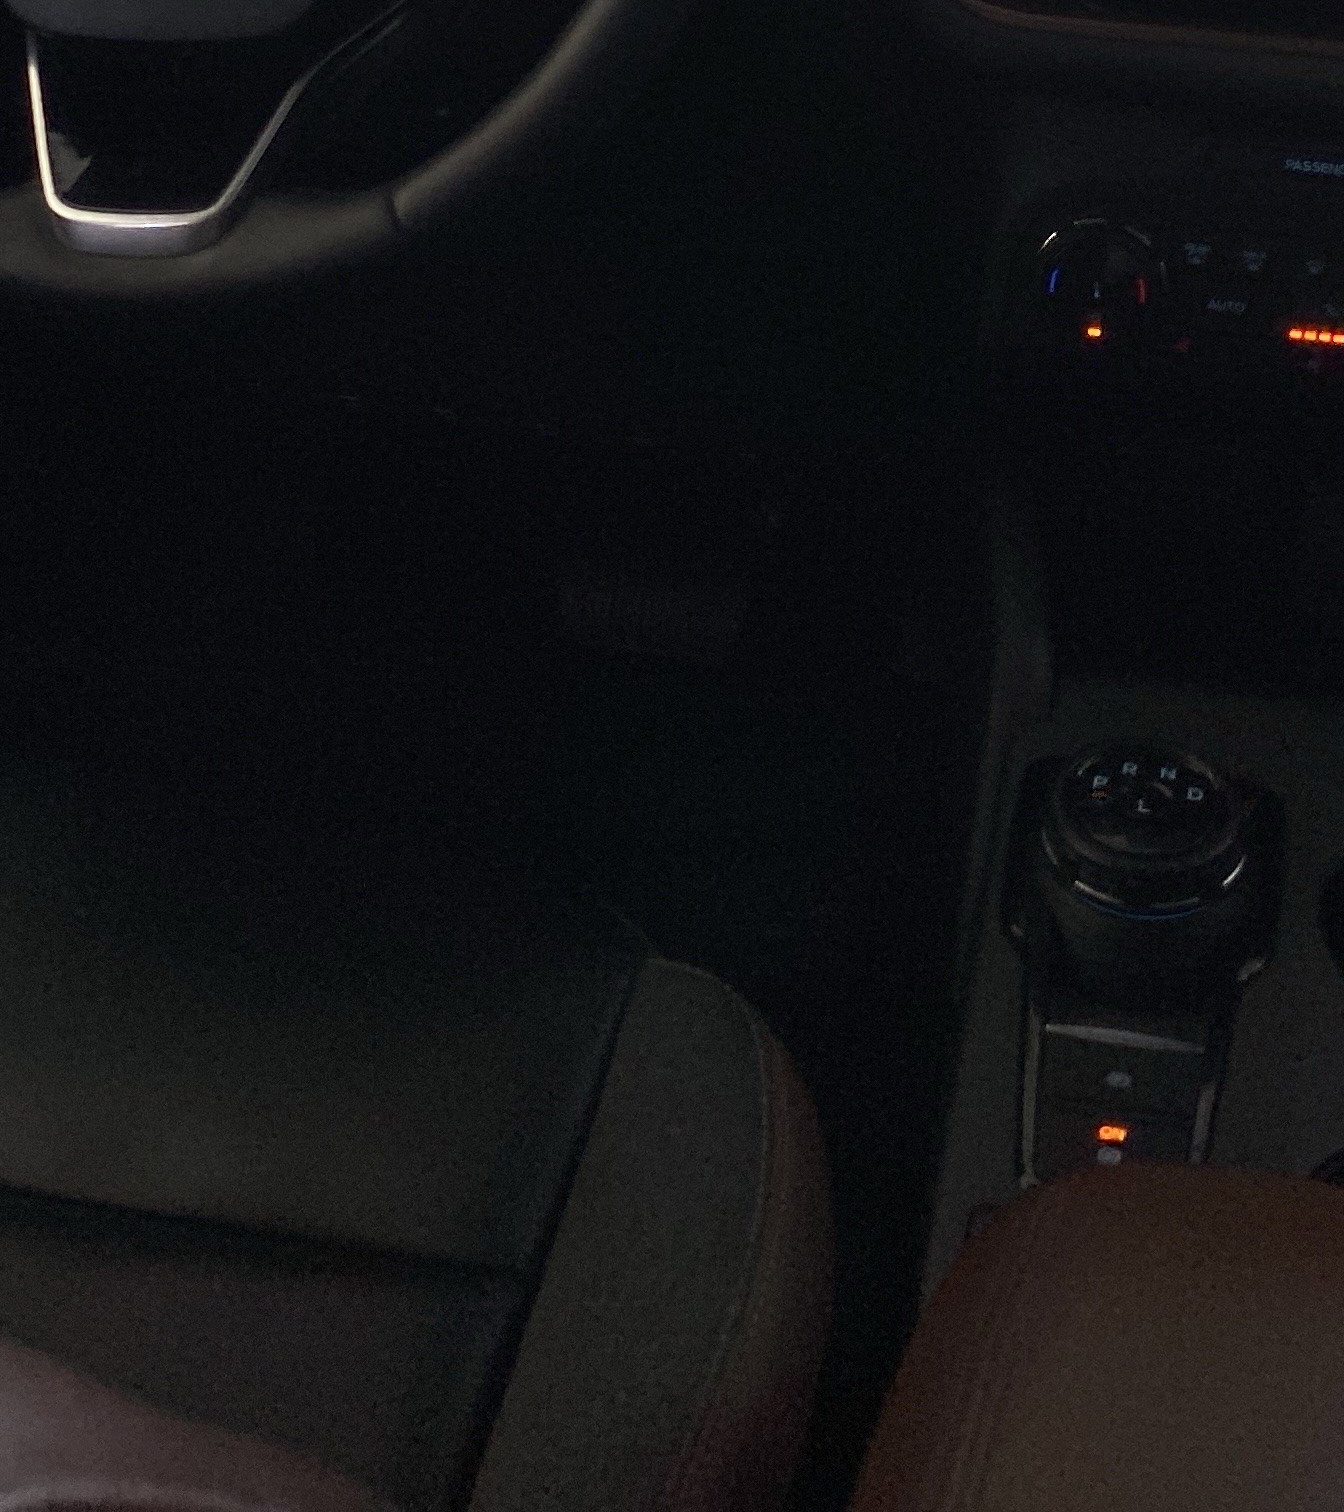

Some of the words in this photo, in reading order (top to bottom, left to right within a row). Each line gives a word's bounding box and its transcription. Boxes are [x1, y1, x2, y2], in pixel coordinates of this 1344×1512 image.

[1122, 761, 1138, 777] R
[1160, 766, 1177, 781] N
[1093, 775, 1109, 789] P
[1186, 786, 1204, 801] D
[1137, 798, 1152, 813] L
